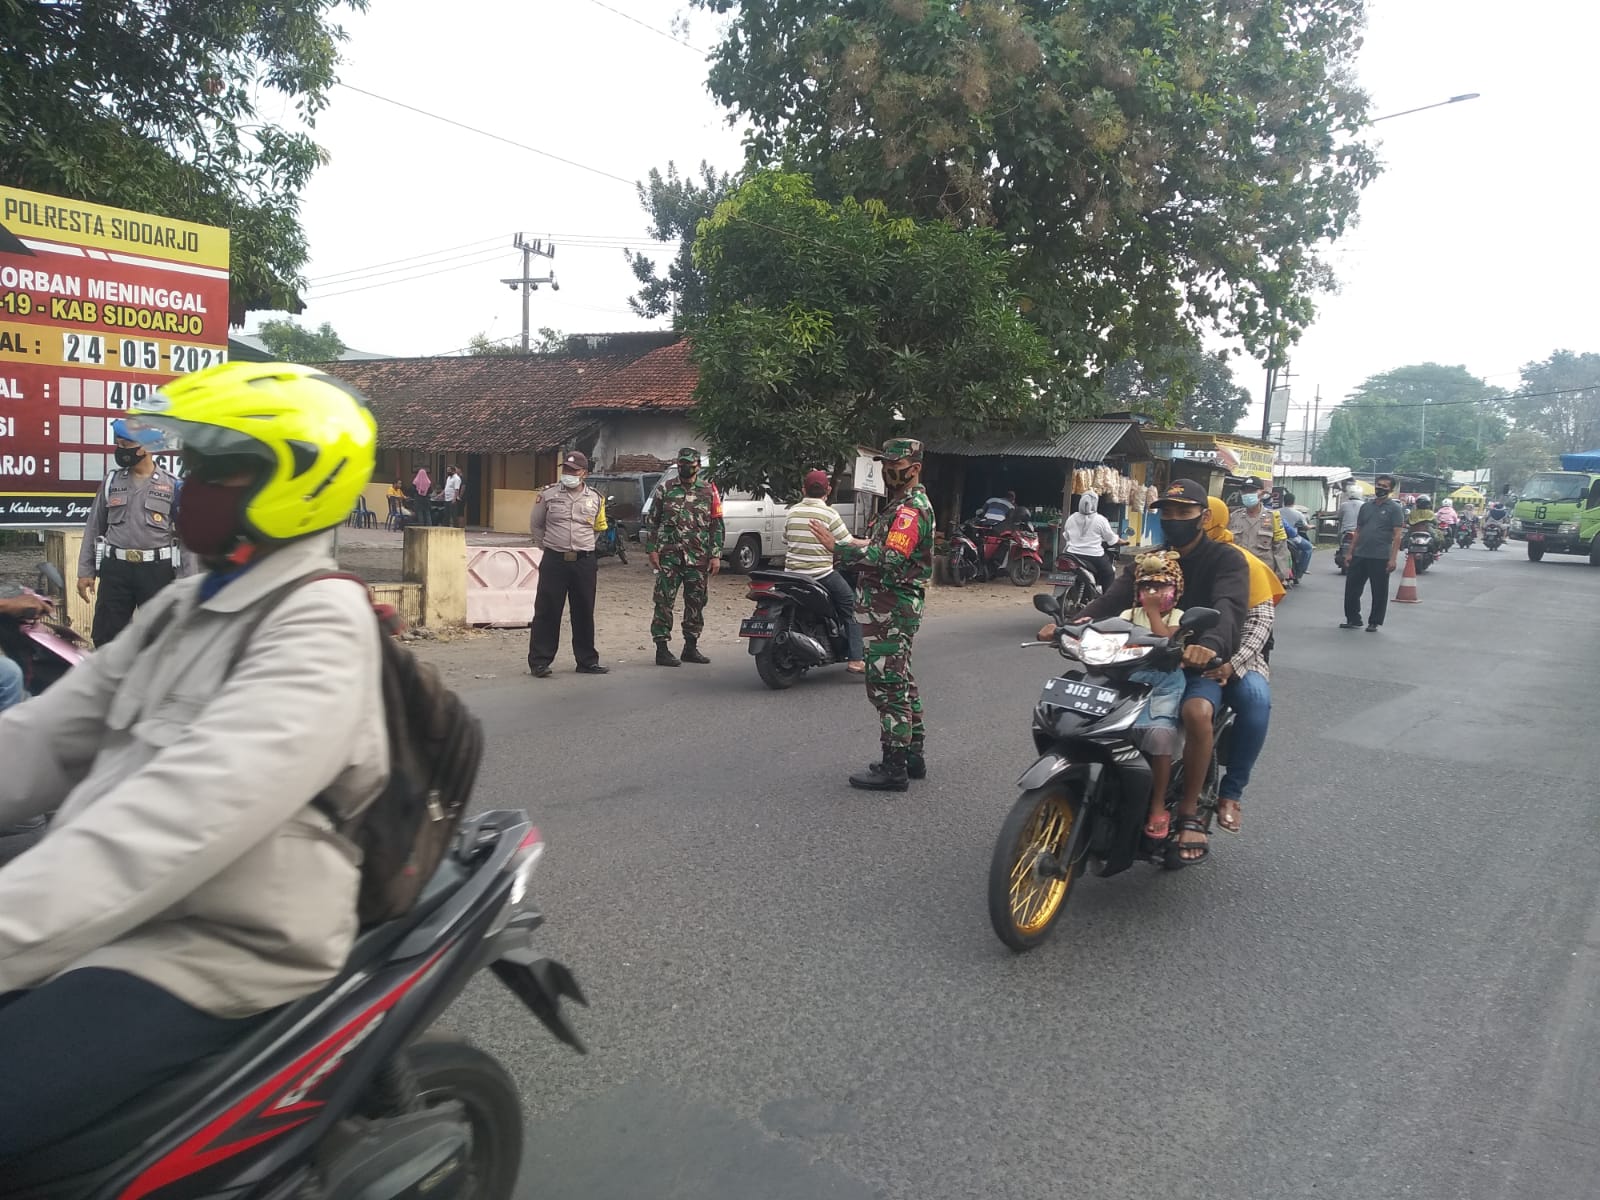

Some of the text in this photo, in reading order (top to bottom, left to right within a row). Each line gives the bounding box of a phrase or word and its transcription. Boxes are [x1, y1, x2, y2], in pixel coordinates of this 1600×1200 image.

[5, 197, 199, 253] POLRESTA SIDOARJO
[0, 266, 207, 314] ORBAN MENINGGAL
[51, 297, 97, 324] KAB
[102, 304, 204, 336] SIDOARJO
[0, 455, 36, 476] RJO
[1534, 506, 1548, 520] 18
[1045, 679, 1057, 690] W
